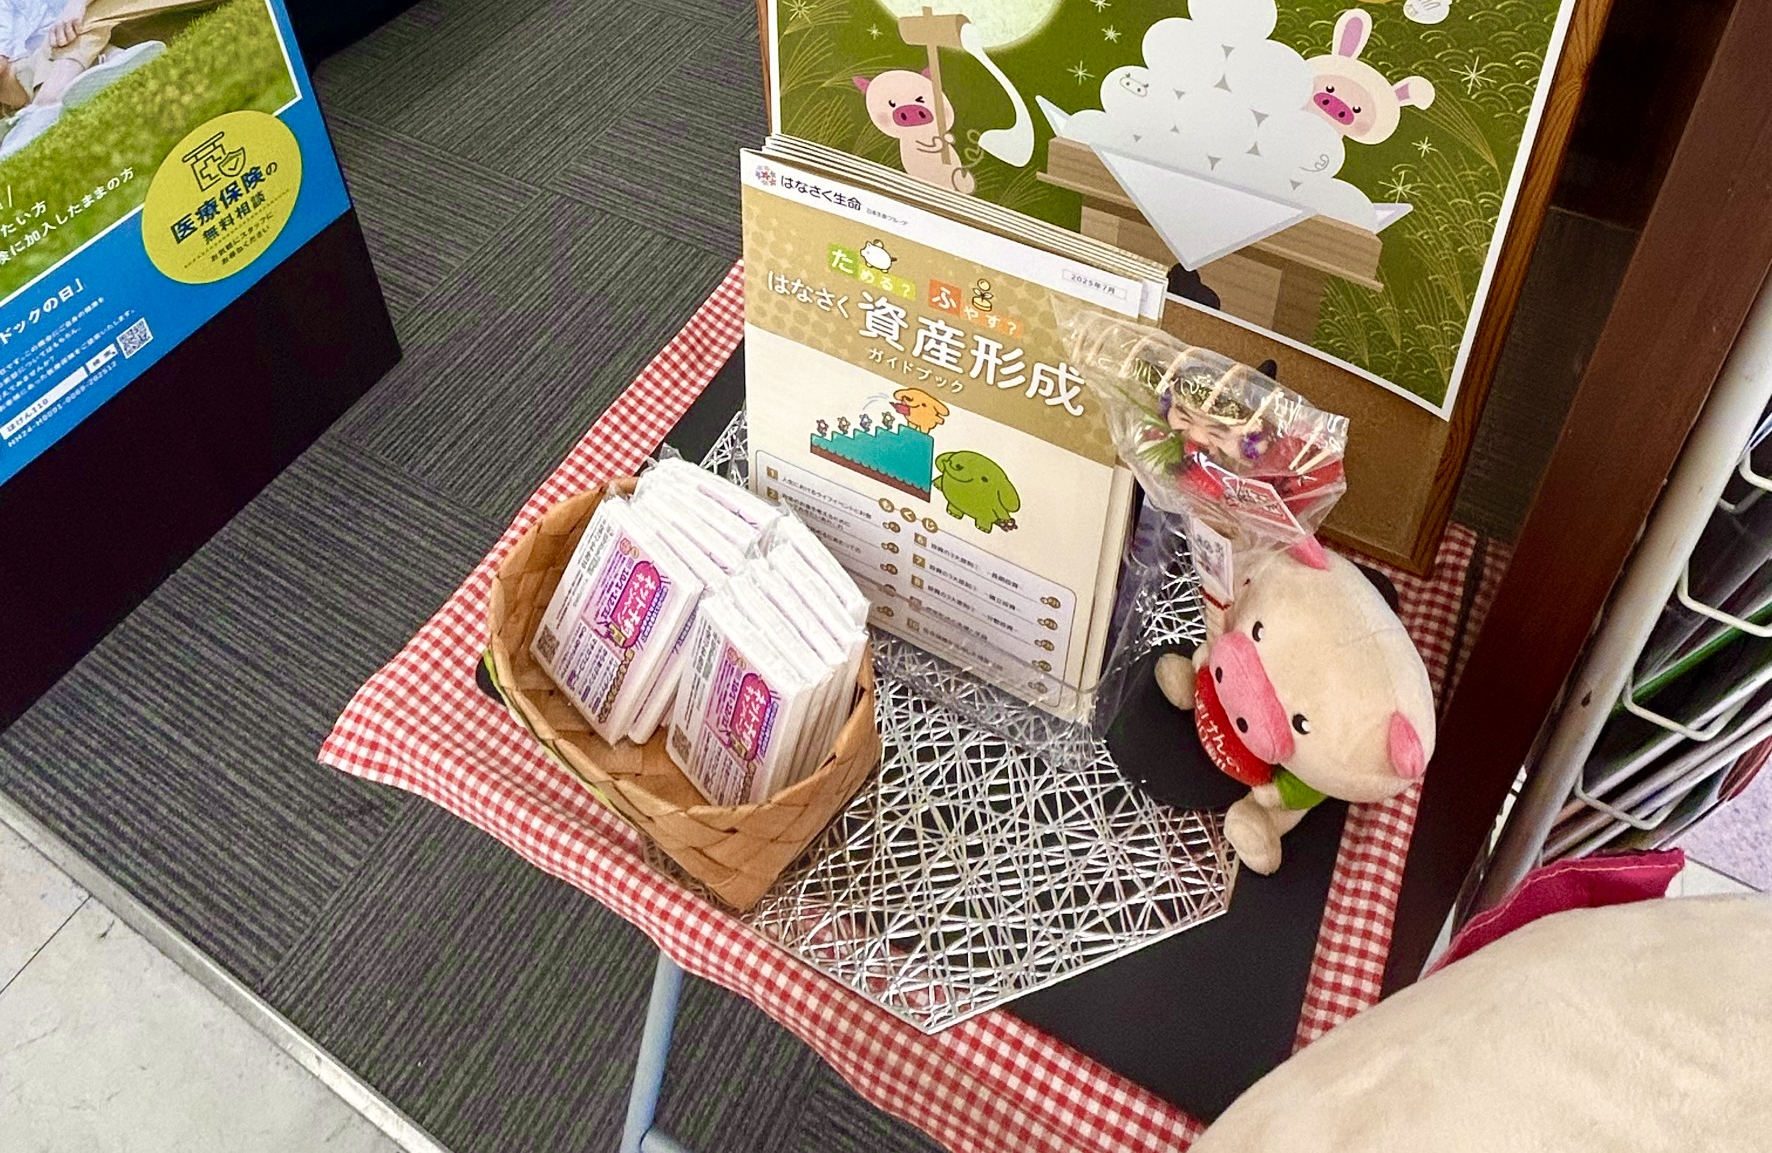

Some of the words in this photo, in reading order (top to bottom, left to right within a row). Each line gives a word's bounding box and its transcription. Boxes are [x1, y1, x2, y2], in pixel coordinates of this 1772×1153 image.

[170, 162, 278, 245] 医療保険の
[202, 191, 266, 244] 無料相談
[780, 175, 862, 212] はなさく生命
[1, 200, 46, 238] たい方
[830, 248, 912, 298] ためる?
[1070, 273, 1116, 295] 2025年7月
[932, 285, 1018, 336] ふやす?
[767, 270, 849, 319] はなさく
[857, 291, 1085, 416] 資産形成
[868, 347, 965, 394] ガイドブック
[7, 398, 49, 433] ほけん110
